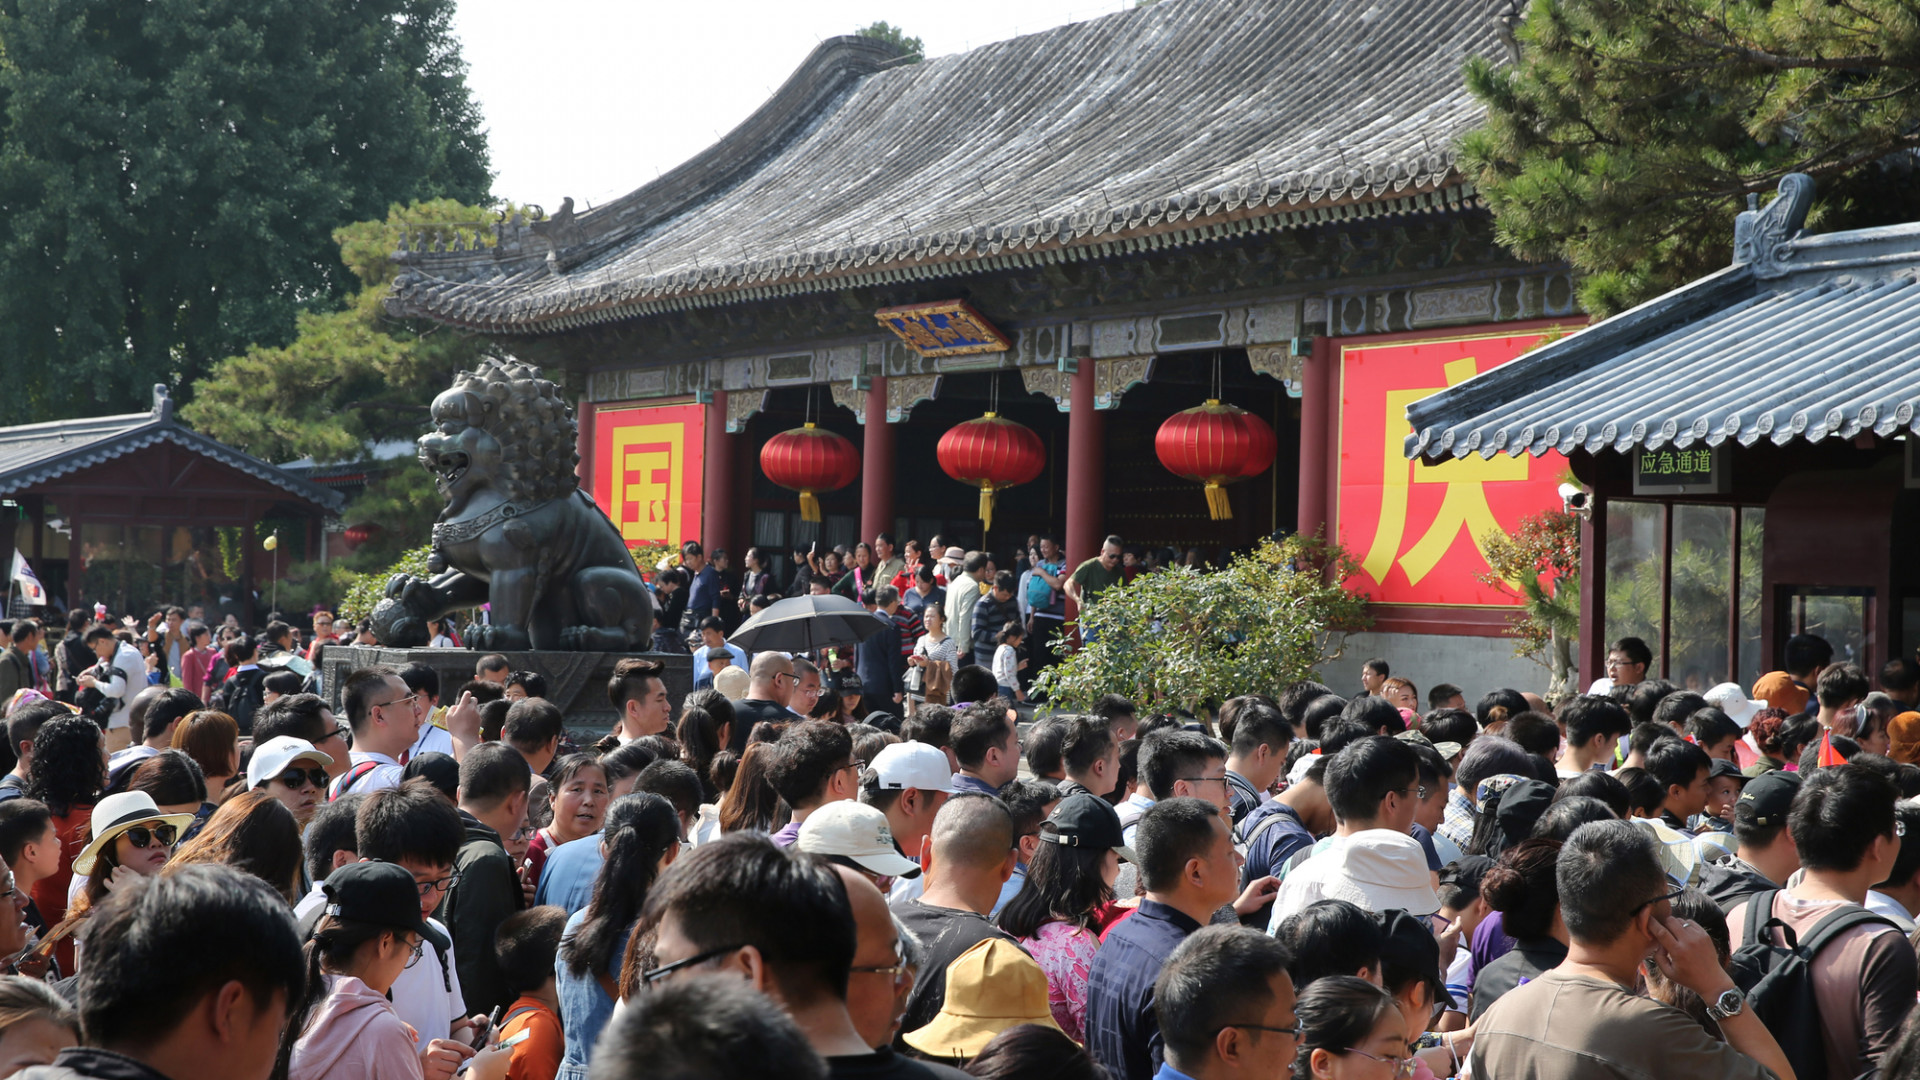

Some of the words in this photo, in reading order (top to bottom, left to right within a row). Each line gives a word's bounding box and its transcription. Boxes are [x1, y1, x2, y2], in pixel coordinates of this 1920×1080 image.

[610, 421, 684, 566] 国
[1361, 356, 1529, 592] 庆
[1640, 449, 1711, 474] 应急通道
